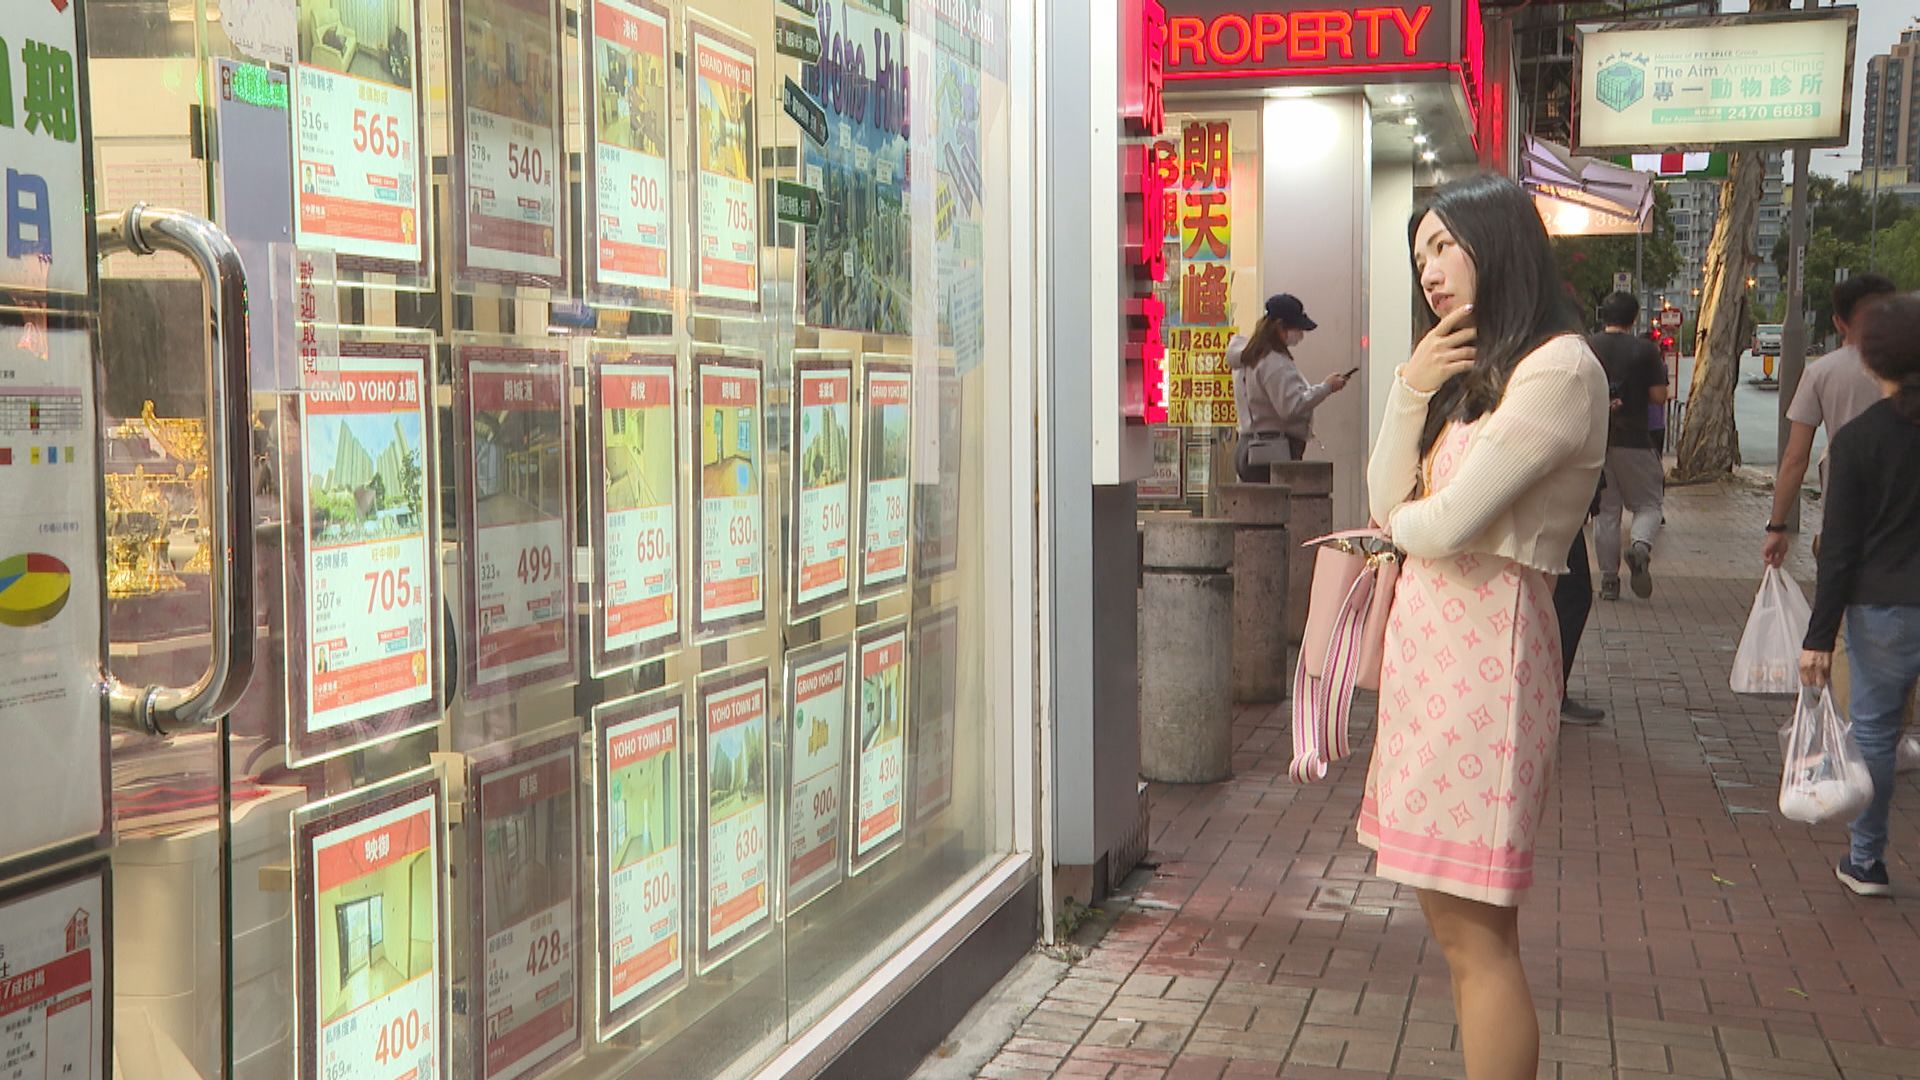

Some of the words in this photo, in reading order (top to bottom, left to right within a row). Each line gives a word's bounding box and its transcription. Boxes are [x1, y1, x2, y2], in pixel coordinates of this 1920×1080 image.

[1161, 5, 1433, 66] ROPERTY
[699, 52, 722, 74] GRAND
[1655, 66, 1683, 78] The
[1687, 64, 1718, 78] Aim
[1724, 61, 1776, 77] Animal
[1781, 58, 1824, 74] Clinic
[0, 36, 77, 143] 期
[1653, 72, 1824, 101] 專一動物診所
[302, 110, 322, 131] 516
[1728, 106, 1768, 120] 2470
[1772, 103, 1814, 118] 6683
[353, 107, 400, 159] 565
[471, 143, 486, 162] 578
[508, 142, 542, 186] 540
[630, 173, 658, 213] 500
[725, 197, 748, 232] 705
[1180, 121, 1231, 327] 朗天峰
[310, 381, 356, 403] GRAND
[359, 380, 396, 403] YOHO
[398, 379, 418, 404] 1期
[822, 502, 841, 531] 510
[886, 495, 901, 521] 738
[637, 527, 664, 564] 650
[729, 515, 752, 545] 630
[481, 564, 496, 581] 323
[517, 544, 552, 585] 499
[316, 591, 335, 611] 507
[364, 566, 411, 614] 705
[798, 675, 818, 696] GRAND
[711, 706, 731, 724] YOHO
[731, 698, 751, 718] TOWN
[613, 740, 636, 760] YOHO
[638, 731, 661, 749] TOWN
[879, 754, 896, 785] 430
[813, 785, 833, 820] 900
[735, 825, 758, 862] 630
[643, 870, 670, 914] 500
[526, 929, 560, 977] 428
[375, 1008, 420, 1067] 400
